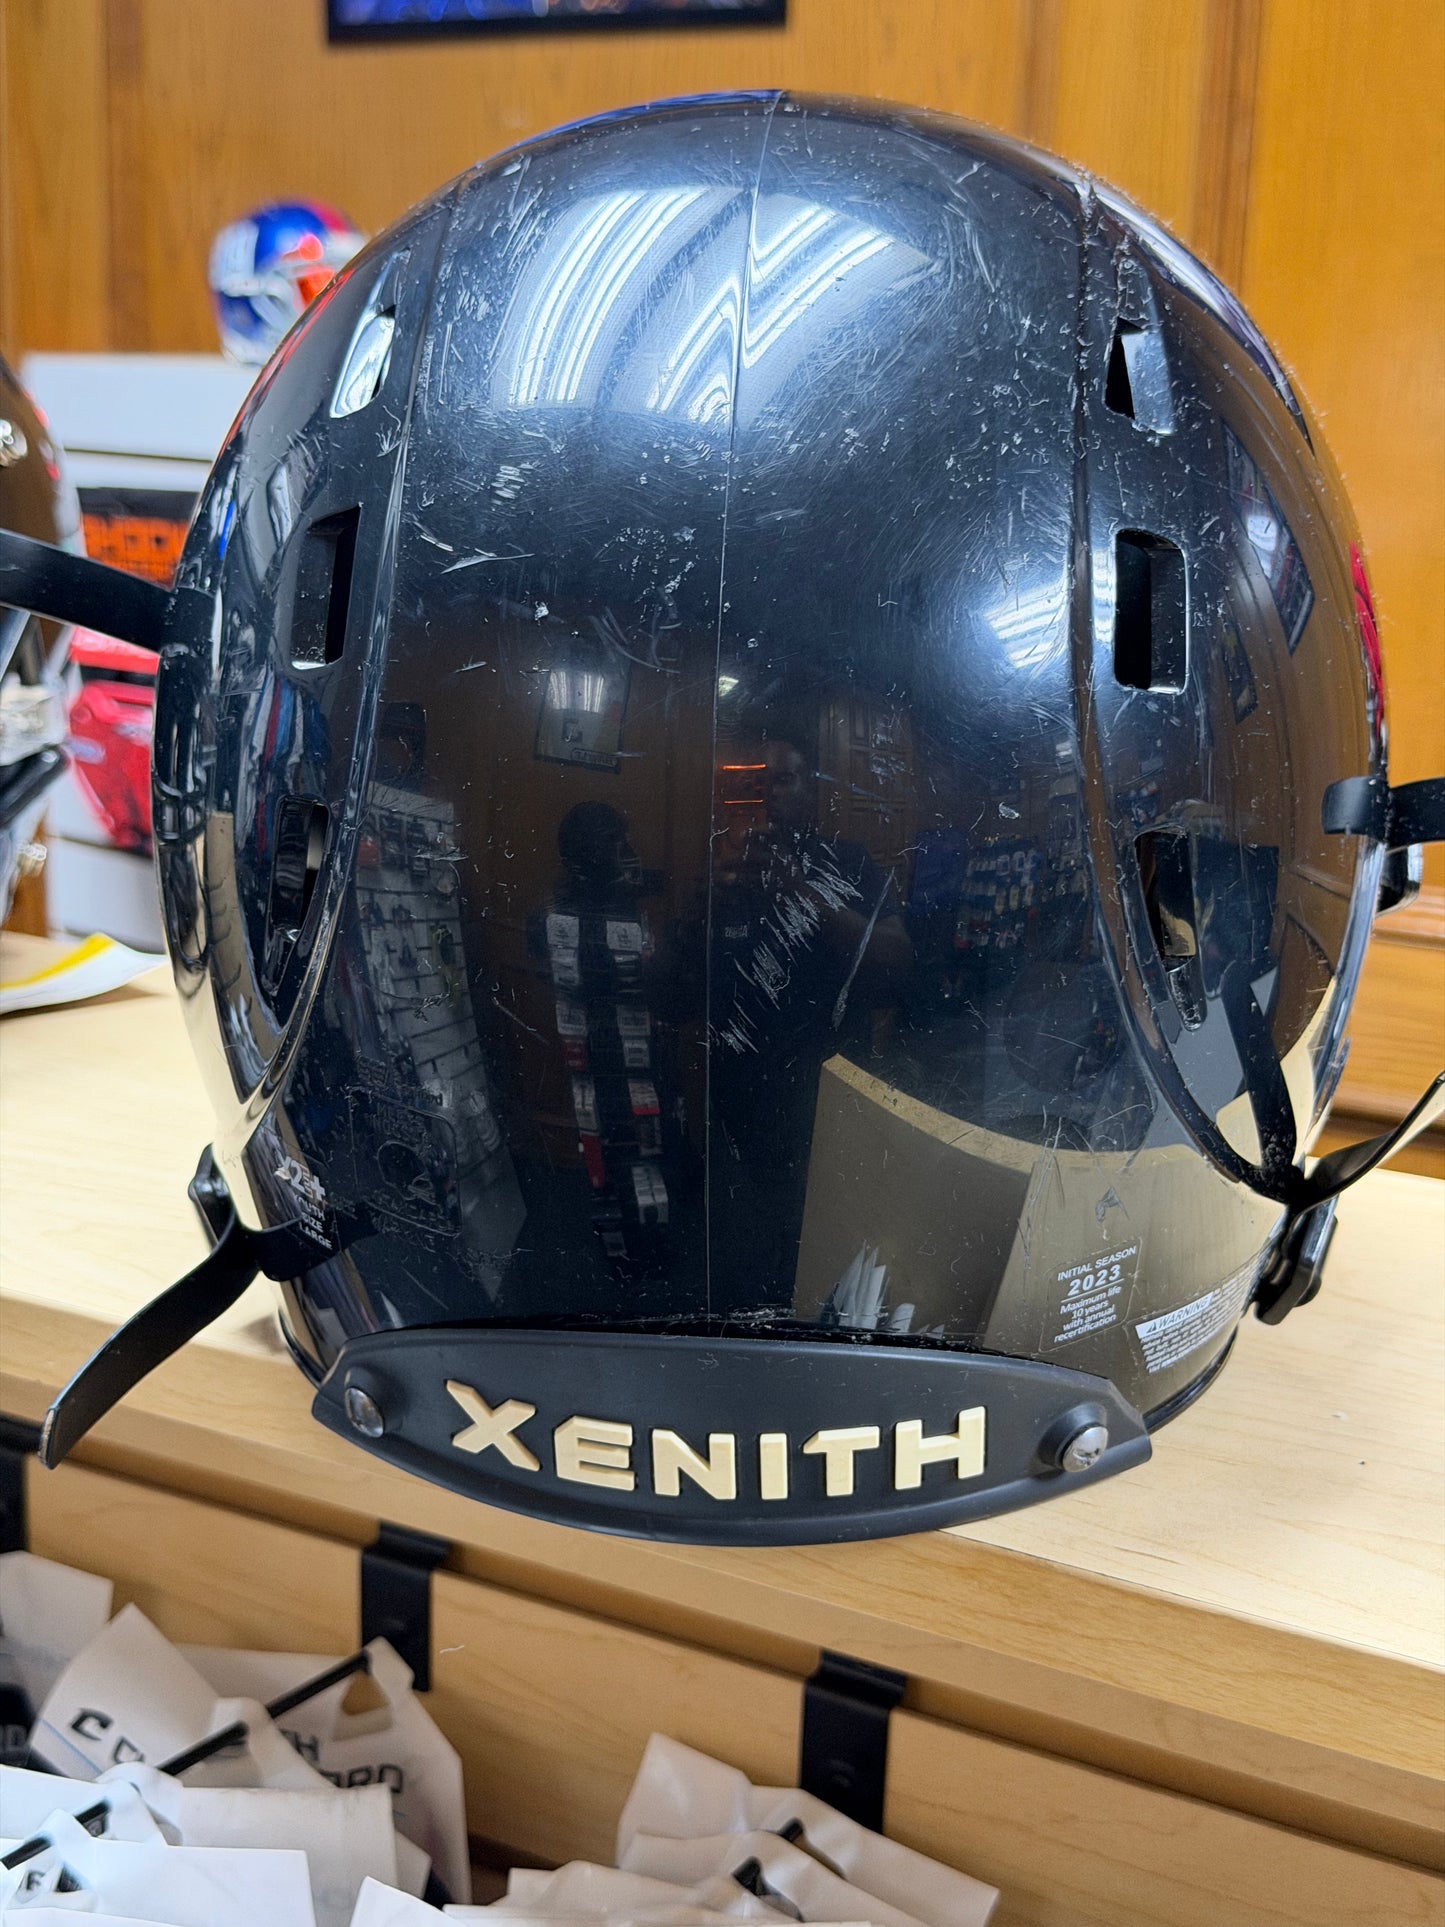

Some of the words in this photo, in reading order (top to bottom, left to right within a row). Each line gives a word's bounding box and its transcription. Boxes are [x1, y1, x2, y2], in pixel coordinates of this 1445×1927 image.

[298, 1221, 333, 1250] LARGE
[301, 1212, 324, 1233] SIZE
[1057, 1263, 1093, 1281] INITIAL
[1095, 1245, 1137, 1269] SEASON
[1067, 1264, 1121, 1297] 2023
[1060, 1292, 1106, 1314] Maximum
[1107, 1285, 1122, 1297] life
[1071, 1308, 1083, 1320] 10
[1084, 1299, 1109, 1316] years
[1158, 1297, 1209, 1328] WARNING
[1053, 1314, 1117, 1343] recertification
[1062, 1317, 1083, 1331] with
[1084, 1304, 1115, 1323] annual
[445, 1379, 986, 1500] XENITH
